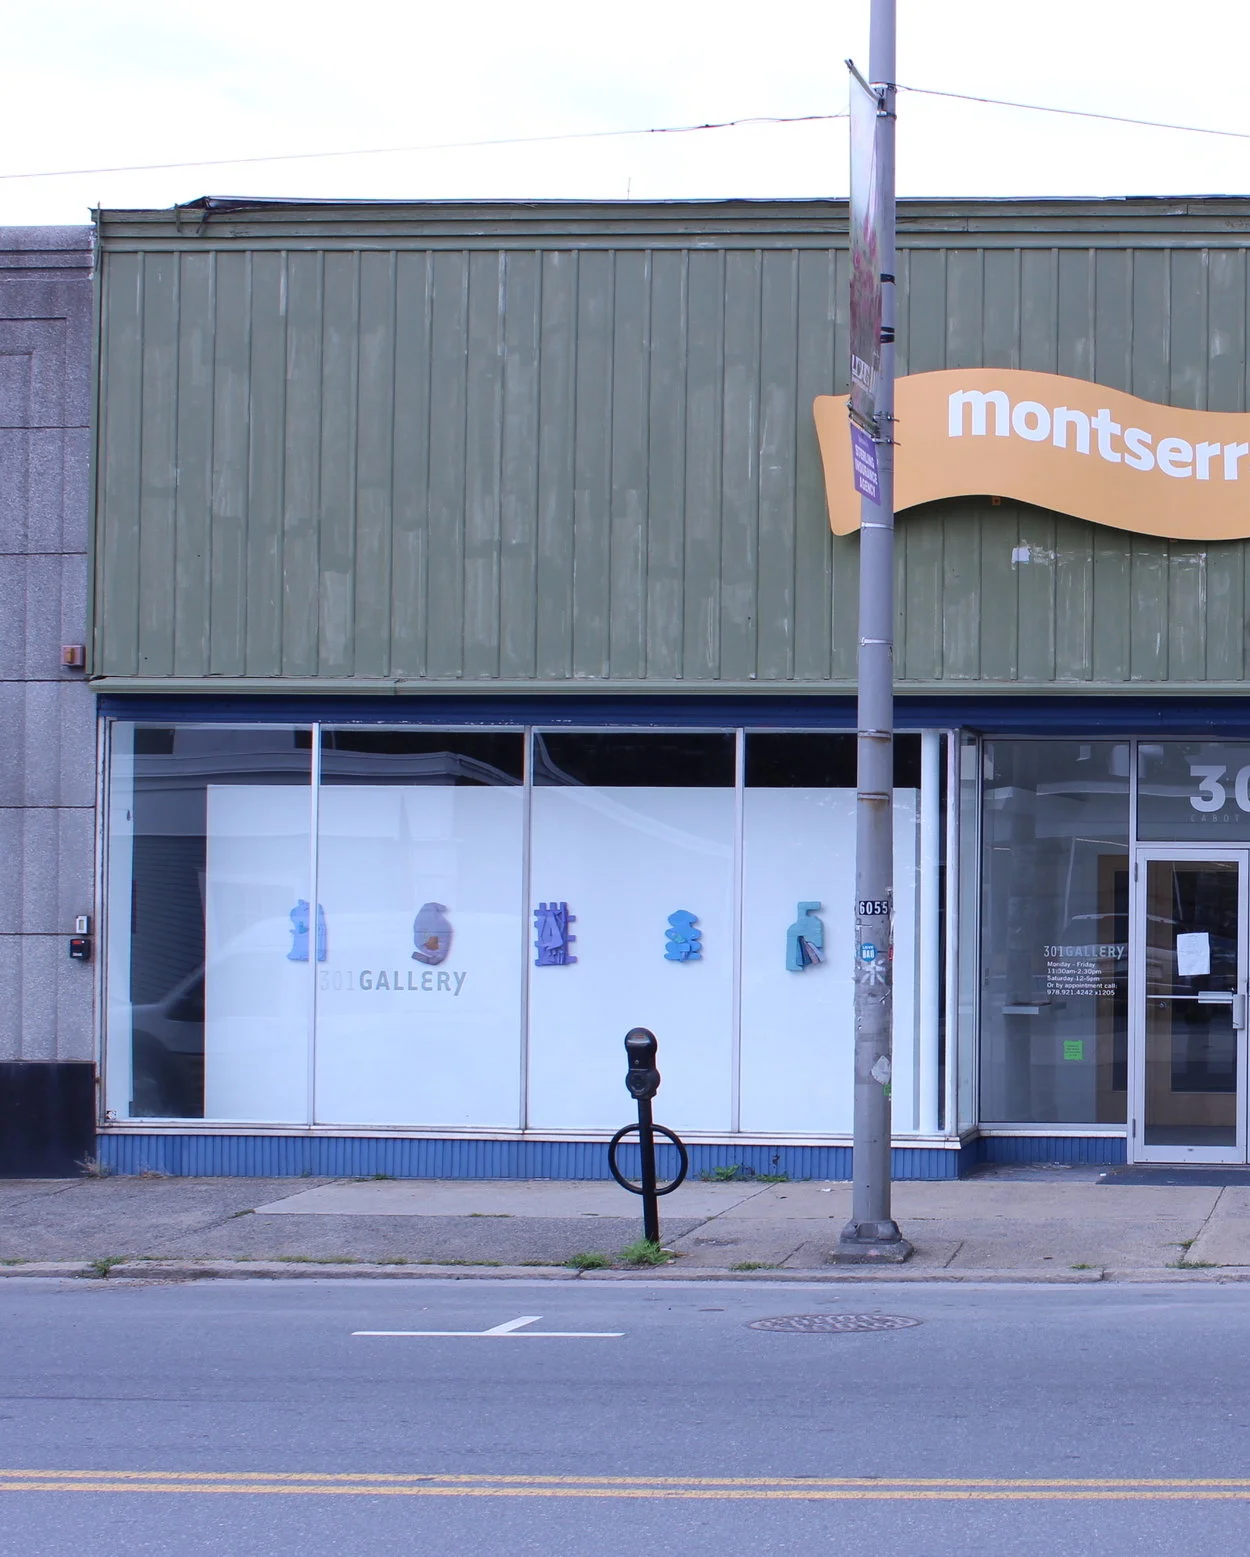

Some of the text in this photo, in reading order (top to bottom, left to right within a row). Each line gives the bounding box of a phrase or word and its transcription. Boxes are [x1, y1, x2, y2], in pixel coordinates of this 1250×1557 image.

[1190, 814, 1240, 823] CABOT
[859, 901, 888, 915] 6055
[1047, 961, 1071, 969] Monday
[1076, 961, 1096, 969] Friday
